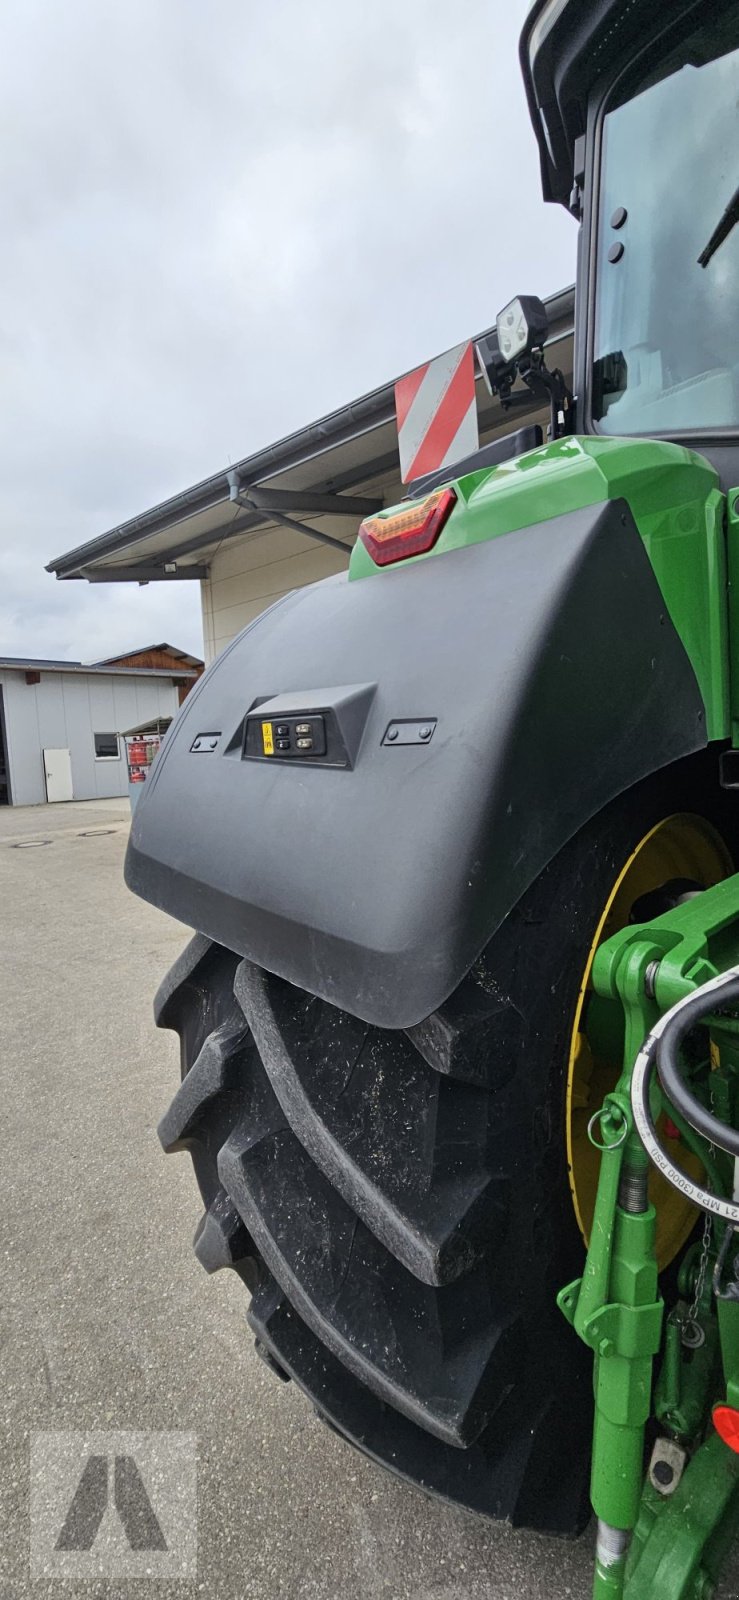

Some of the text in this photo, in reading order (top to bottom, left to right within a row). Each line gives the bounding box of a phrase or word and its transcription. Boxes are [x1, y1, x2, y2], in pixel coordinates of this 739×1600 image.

[651, 1148, 738, 1218] 21 MPa (3000 PSI)
